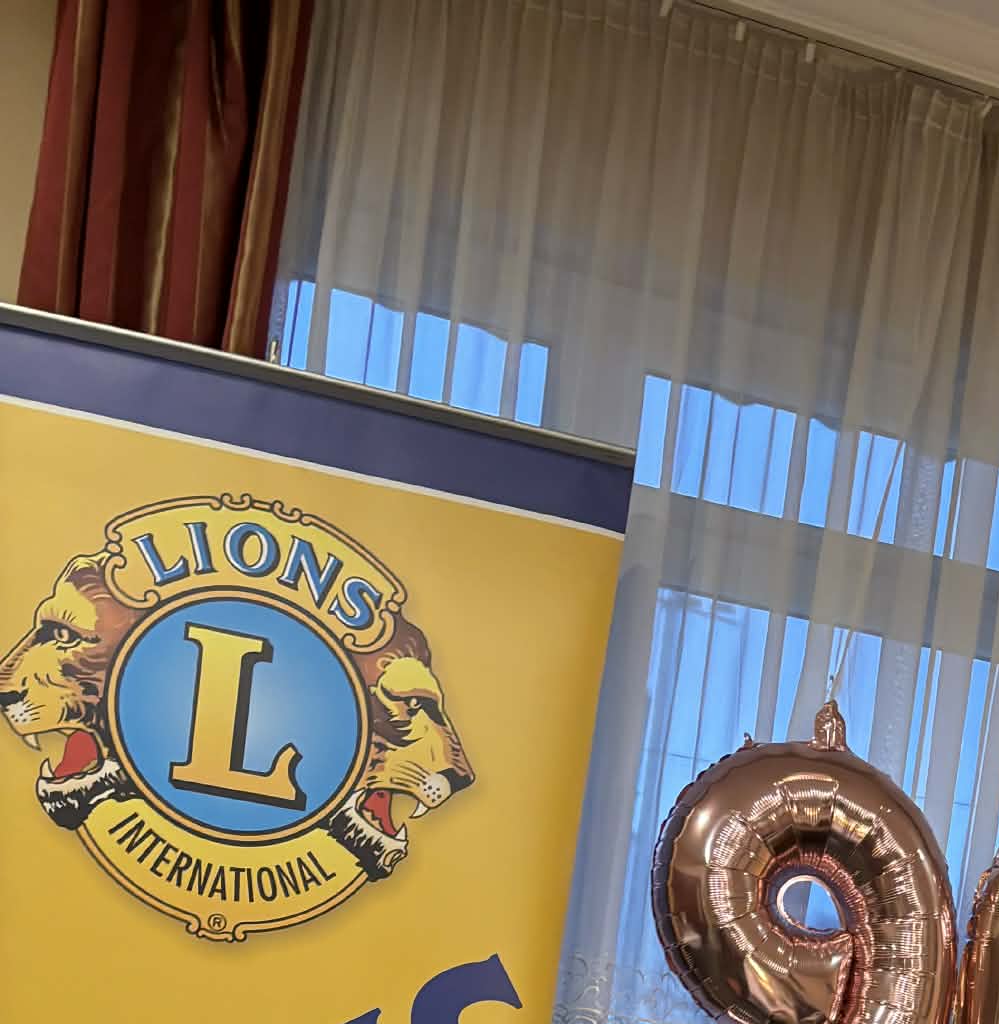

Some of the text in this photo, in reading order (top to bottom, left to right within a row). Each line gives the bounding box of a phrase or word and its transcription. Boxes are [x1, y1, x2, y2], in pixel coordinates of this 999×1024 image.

[133, 520, 382, 631] LIONS
[168, 621, 307, 811] L
[108, 811, 337, 903] INTERNATIONAL
